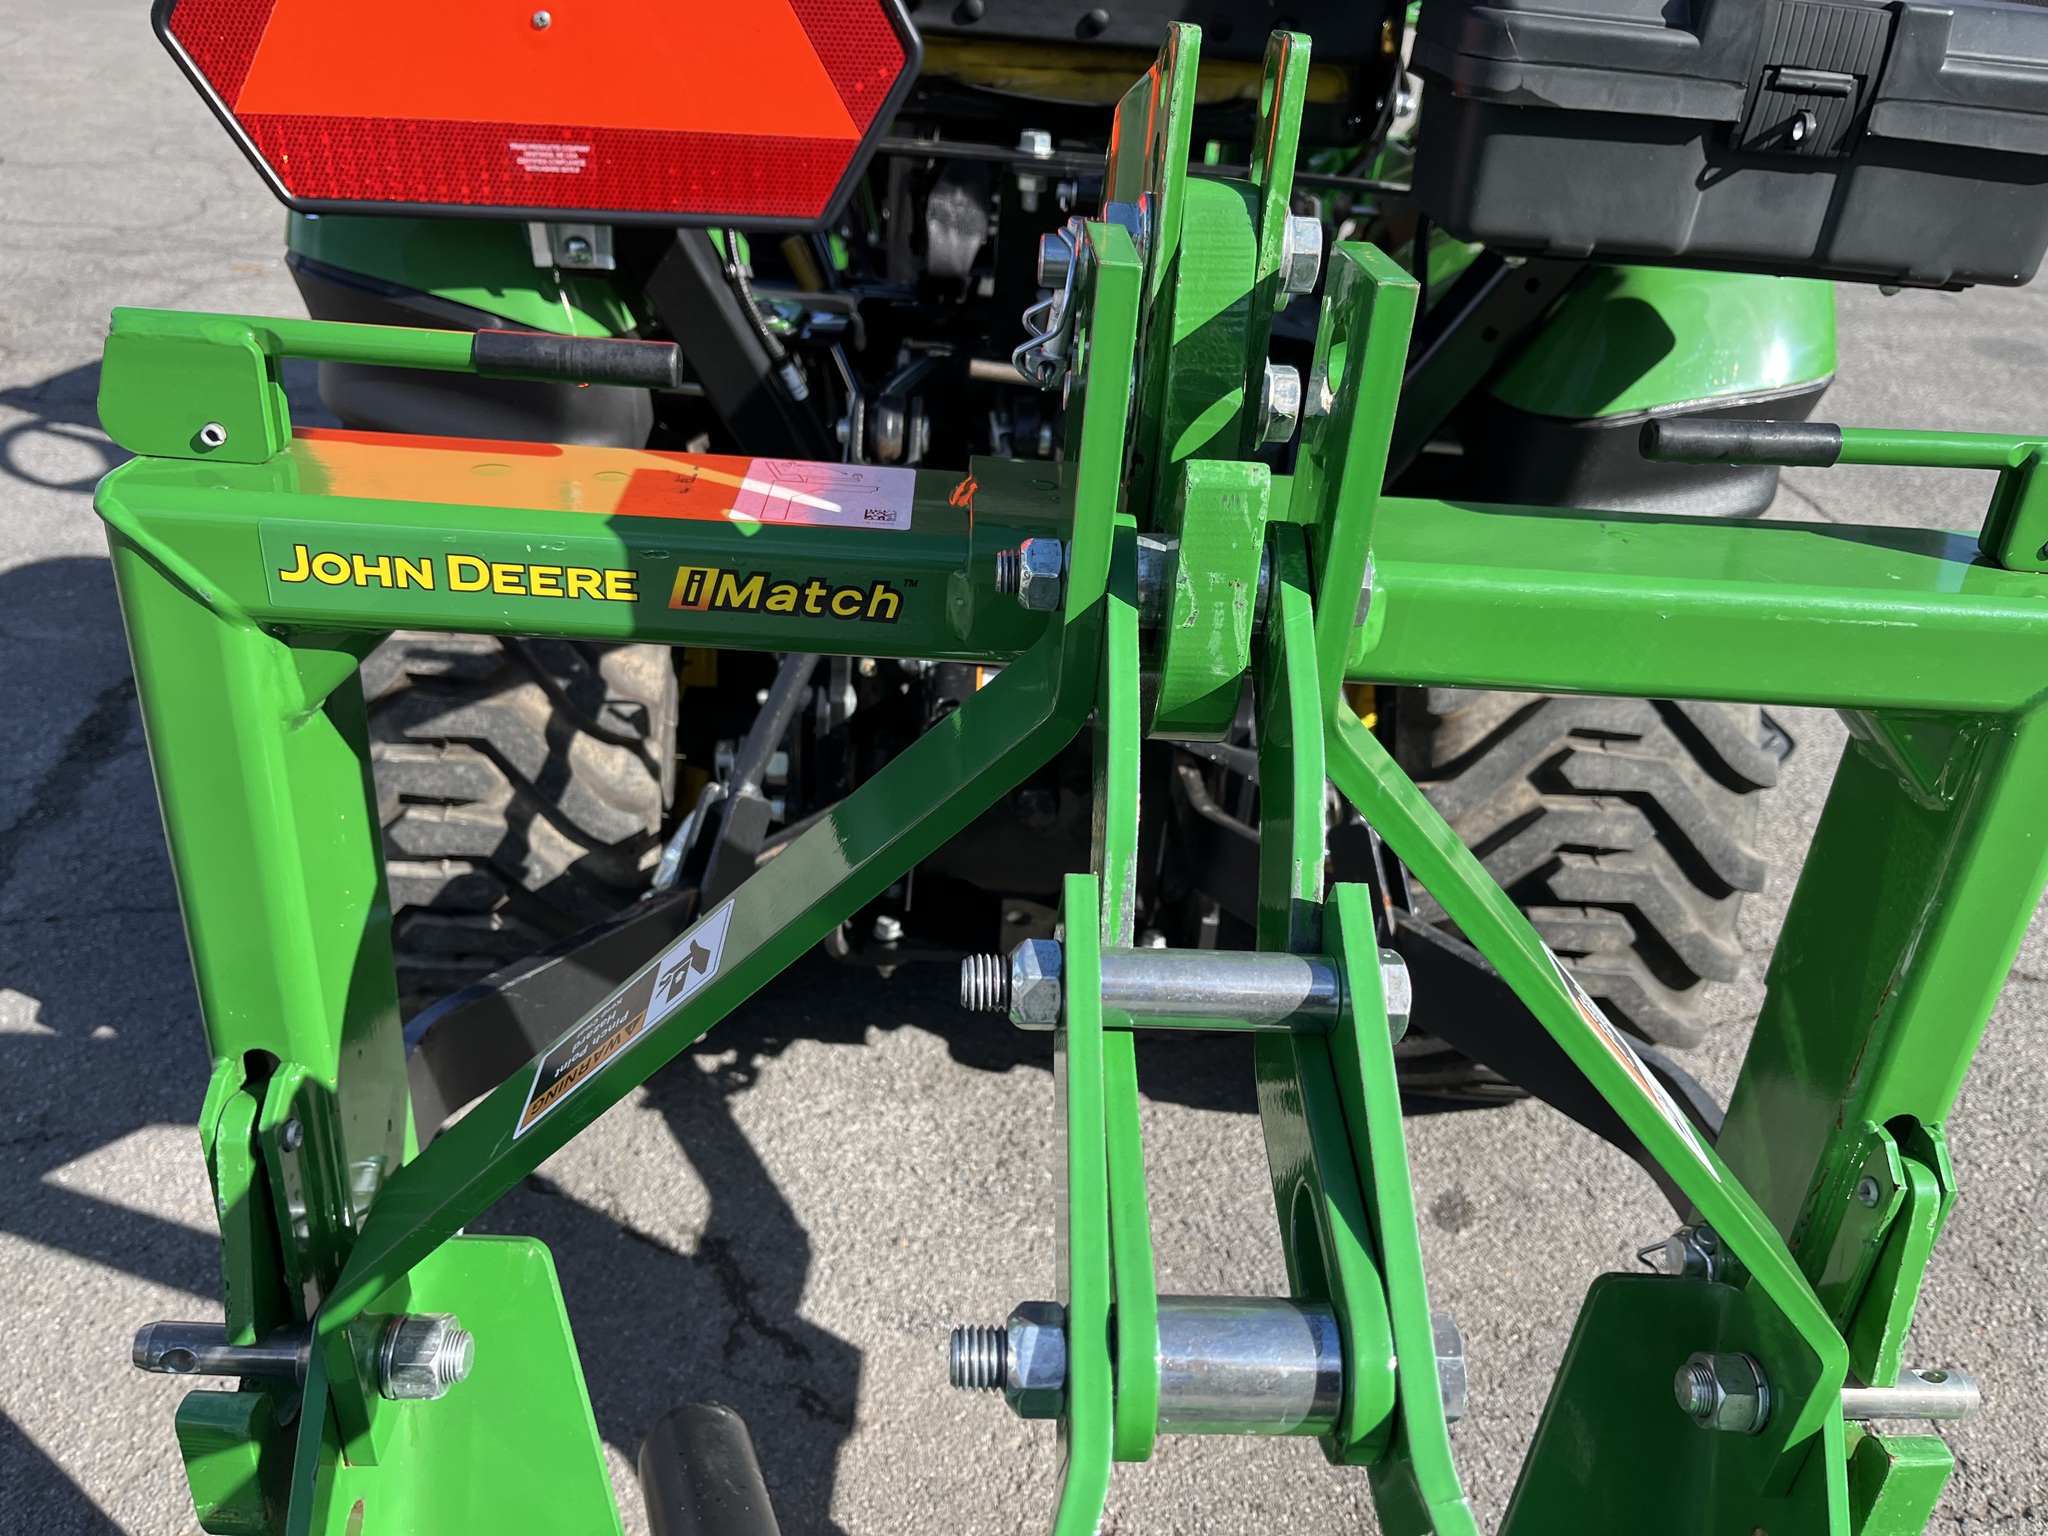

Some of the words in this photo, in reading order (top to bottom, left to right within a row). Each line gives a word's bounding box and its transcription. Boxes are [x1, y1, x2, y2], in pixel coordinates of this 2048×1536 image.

[446, 553, 640, 602] DEERE
[668, 566, 904, 624] iMatch
[571, 1010, 617, 1053] Hazard
[592, 1010, 629, 1045] Pinch
[531, 1033, 621, 1115] WARNING
[554, 1044, 588, 1078] Point
